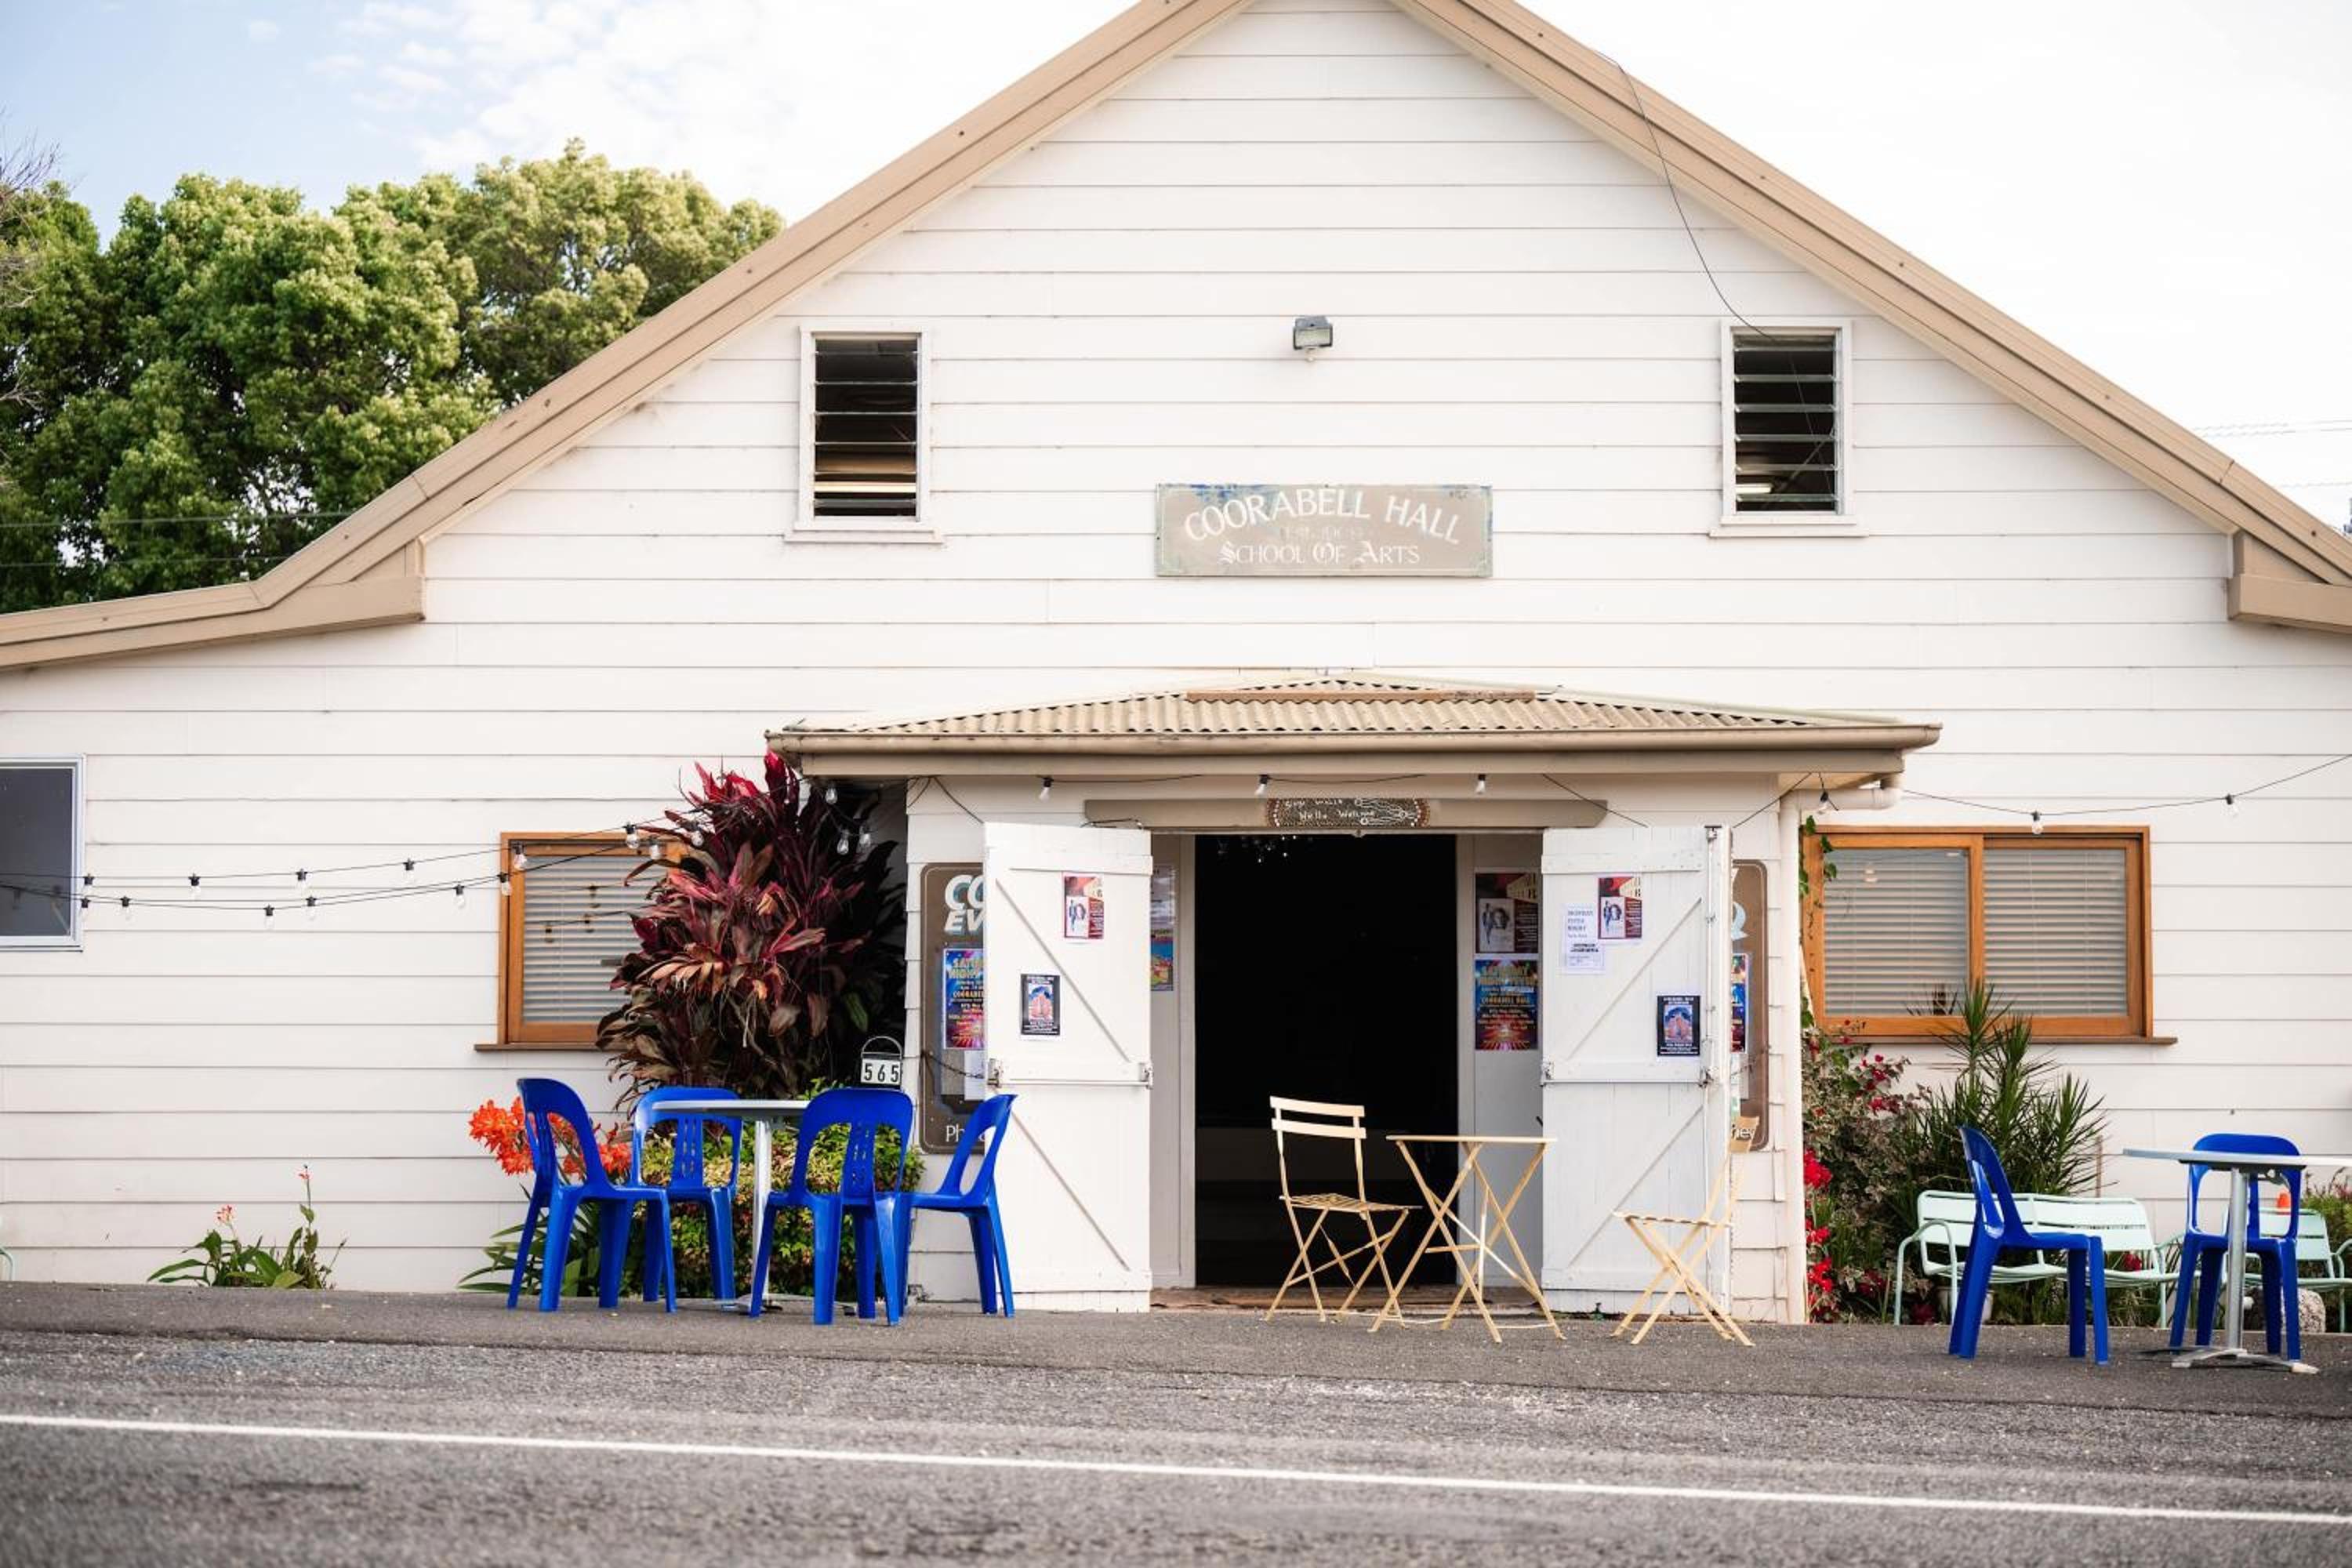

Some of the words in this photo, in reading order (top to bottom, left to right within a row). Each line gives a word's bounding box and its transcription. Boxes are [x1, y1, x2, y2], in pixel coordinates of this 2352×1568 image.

[1185, 488, 1370, 540] COORABELL
[1384, 495, 1460, 545] HALL
[864, 1063, 898, 1082] 565
